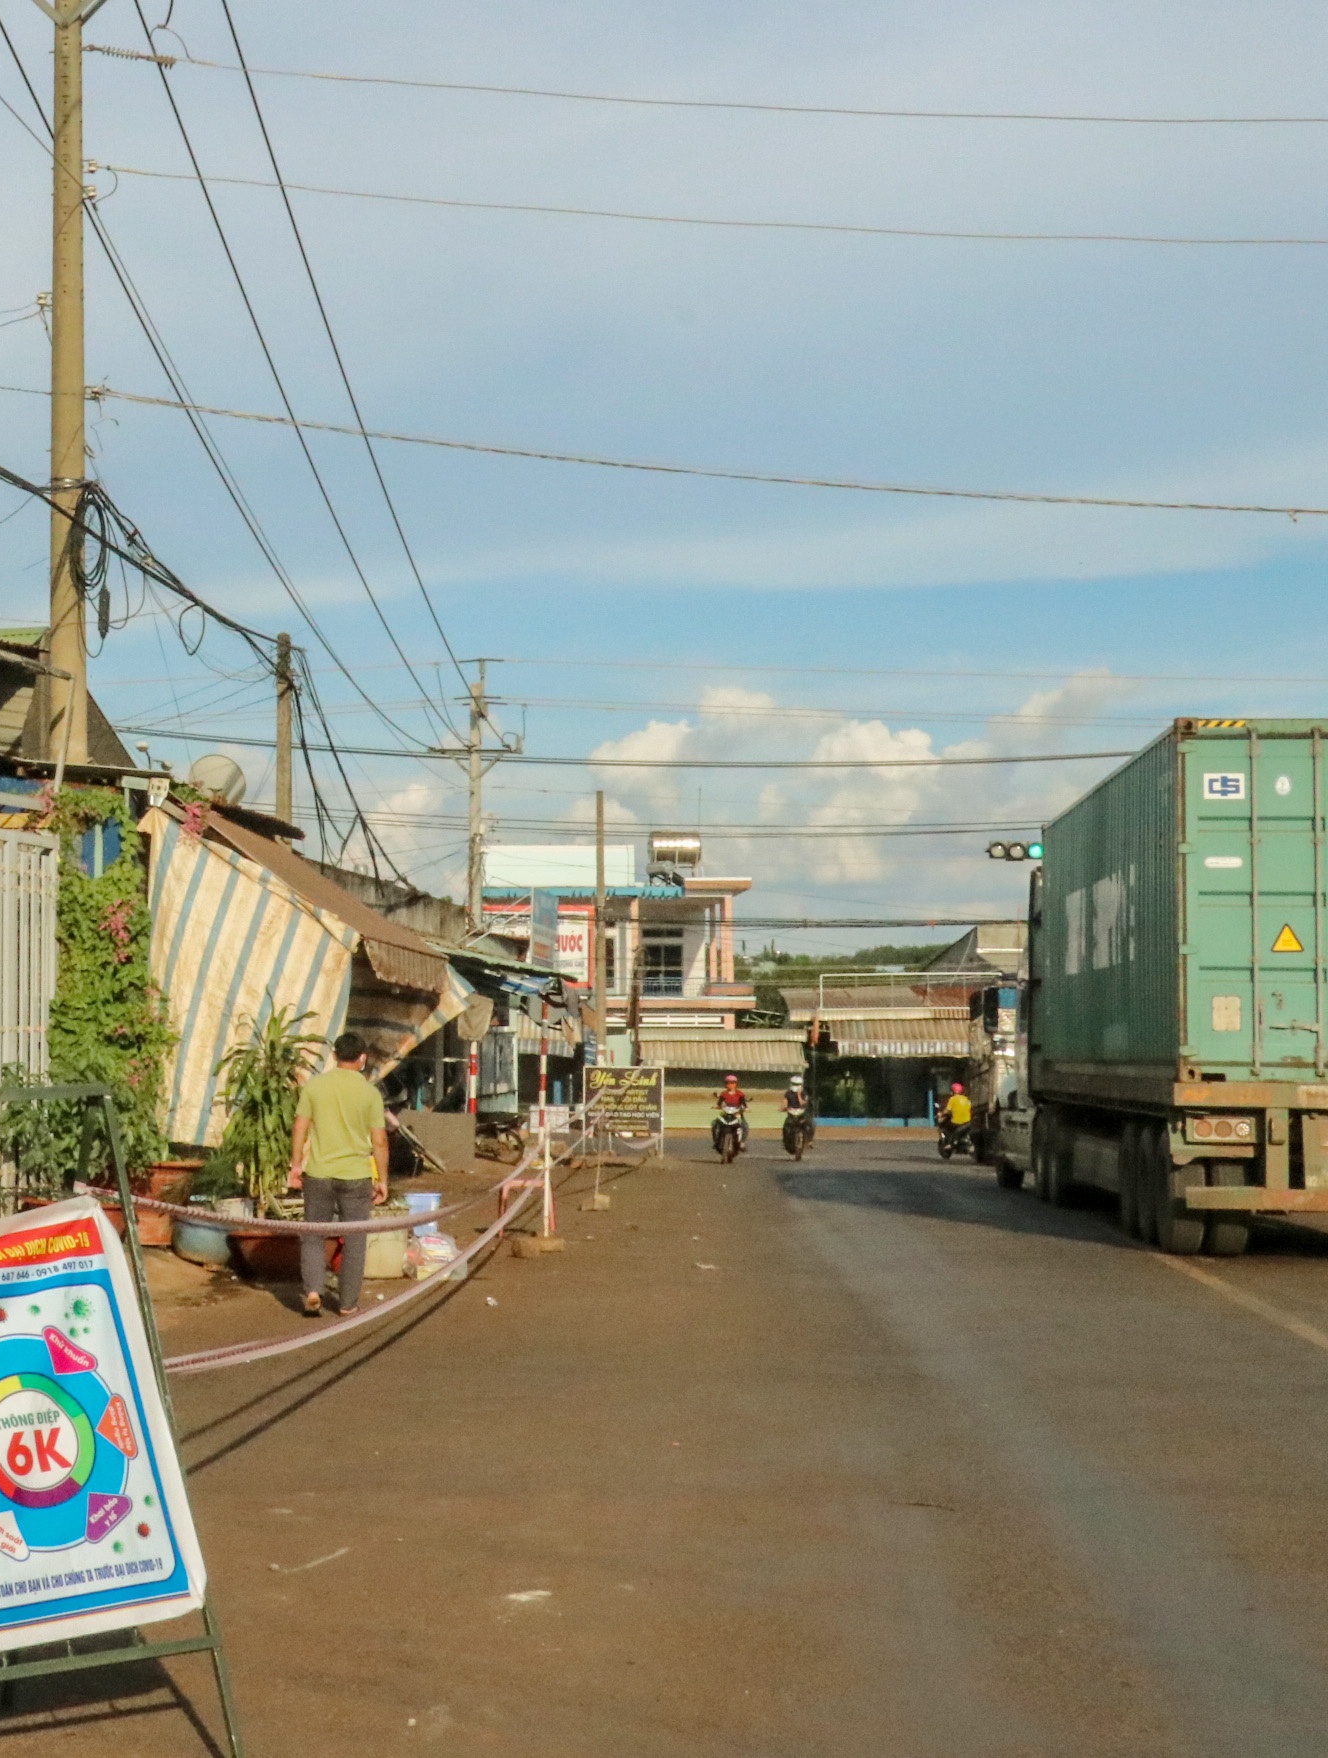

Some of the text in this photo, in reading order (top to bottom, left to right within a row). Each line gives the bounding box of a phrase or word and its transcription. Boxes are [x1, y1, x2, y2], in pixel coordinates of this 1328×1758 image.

[25, 1237, 47, 1260] DỊCH
[47, 1231, 91, 1253] COVID-19
[1, 1271, 15, 1282] 687
[16, 1269, 30, 1280] 646
[36, 1265, 60, 1279] 0918
[62, 1261, 77, 1271] 497
[79, 1259, 94, 1270] 017
[63, 1346, 91, 1368] khuẩn
[36, 1408, 61, 1426] ĐIỆP
[6, 1427, 72, 1477] 6K
[90, 1506, 106, 1525] Khai
[5, 1529, 24, 1546] soát
[15, 1580, 27, 1595] CHO
[28, 1578, 42, 1595] BẠN
[51, 1574, 64, 1588] CHO
[140, 1557, 163, 1573] COVID-19
